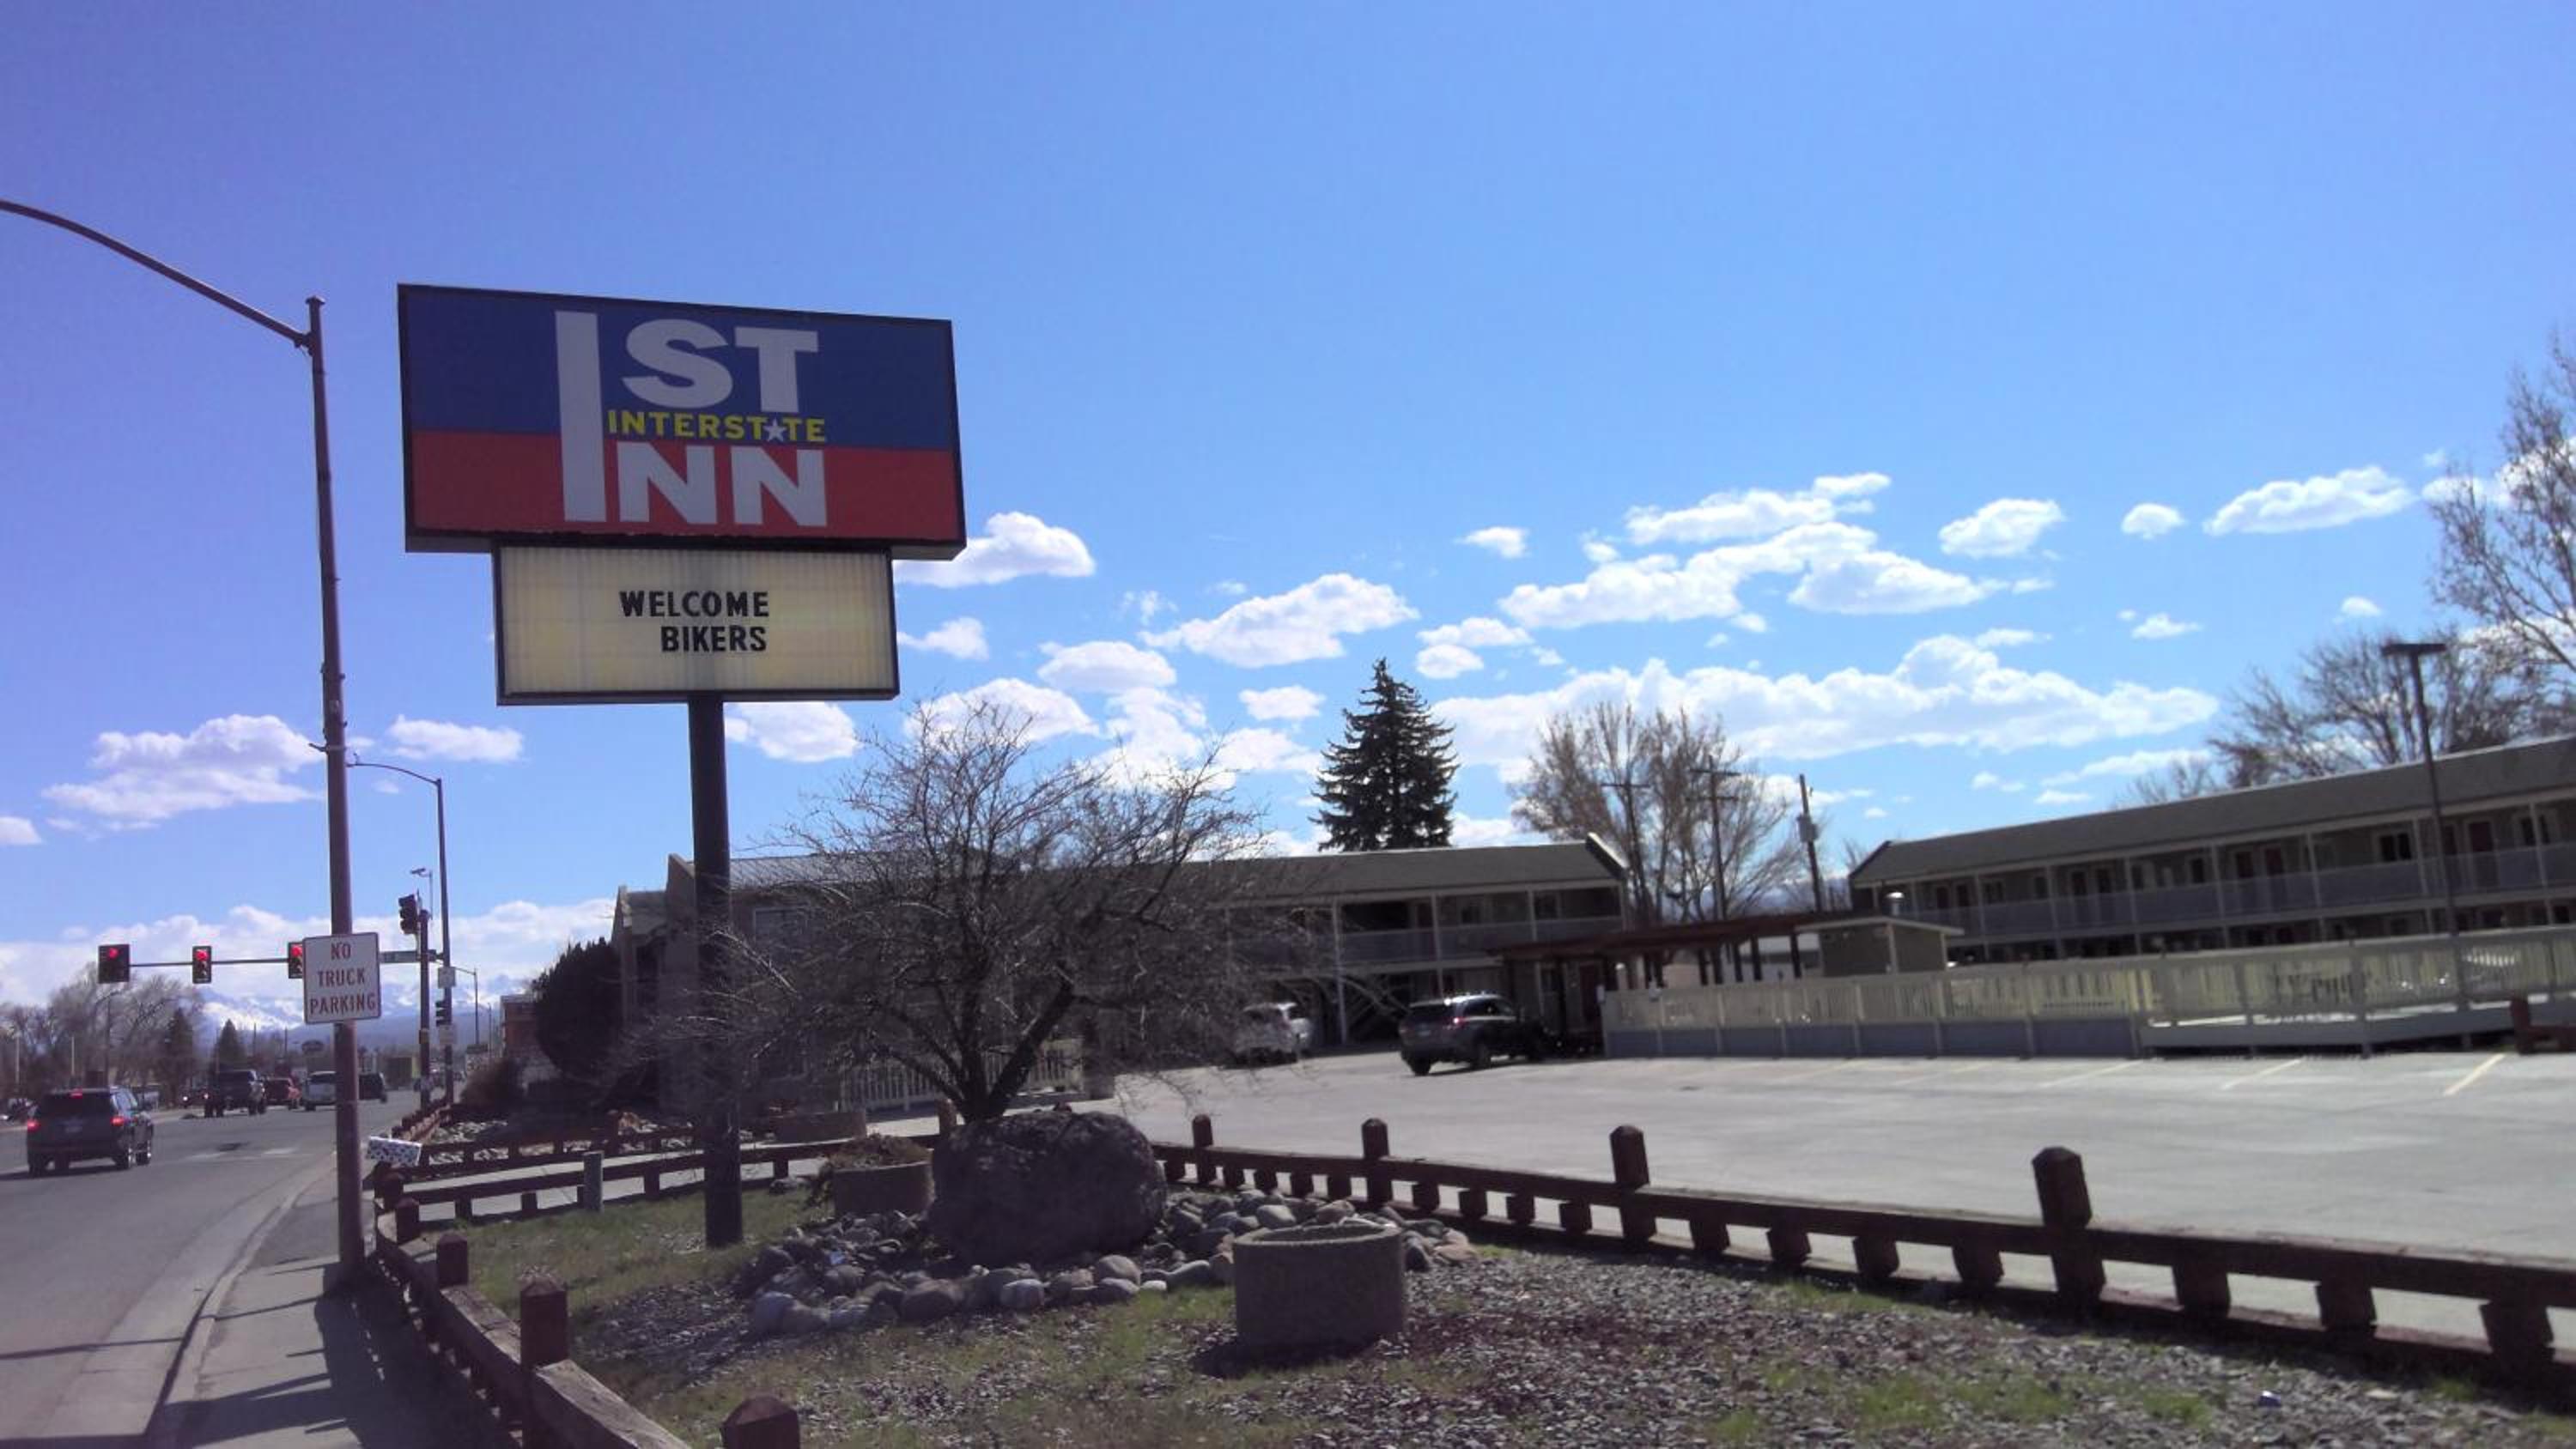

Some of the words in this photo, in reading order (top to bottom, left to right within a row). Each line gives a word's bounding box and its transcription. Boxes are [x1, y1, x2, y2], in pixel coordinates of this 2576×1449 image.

[619, 591, 769, 617] WELCOME
[660, 625, 767, 652] BIKERS
[331, 943, 351, 960] NO
[317, 967, 365, 987] TRUCK
[310, 992, 376, 1014] PARKING
